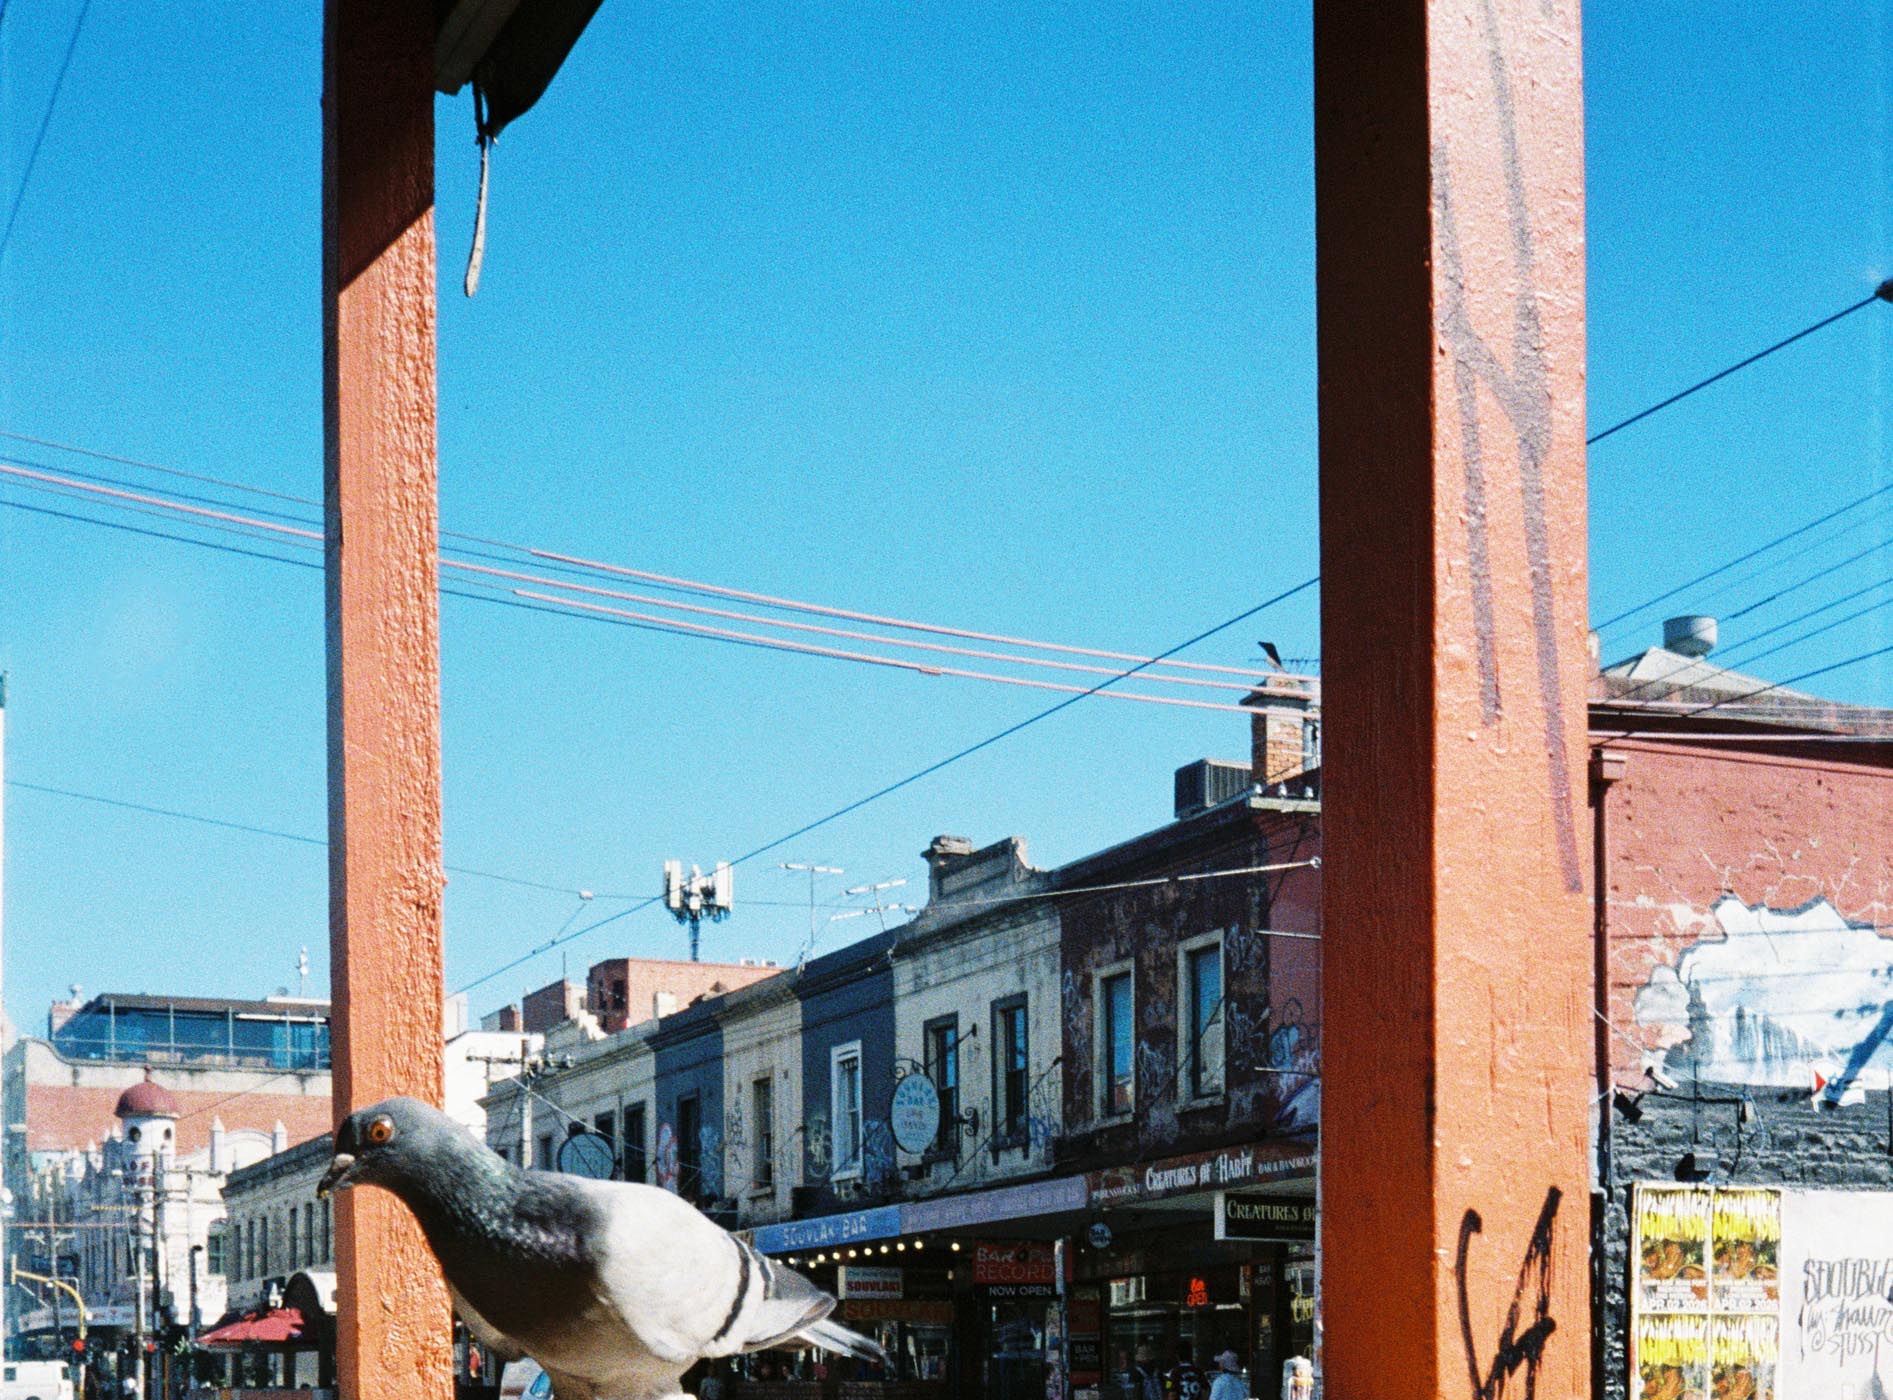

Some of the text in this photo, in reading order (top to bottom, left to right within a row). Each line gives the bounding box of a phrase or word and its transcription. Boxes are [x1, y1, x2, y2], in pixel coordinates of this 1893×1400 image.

[1145, 1165, 1197, 1191] CREATURES
[1215, 1147, 1254, 1183] HABIT
[1227, 1199, 1299, 1222] CREATURES
[842, 1215, 868, 1239] BAR
[976, 1247, 1015, 1263] BAR
[846, 1280, 900, 1292] SOUVLAKI
[989, 1285, 1053, 1297] NOW OPEN
